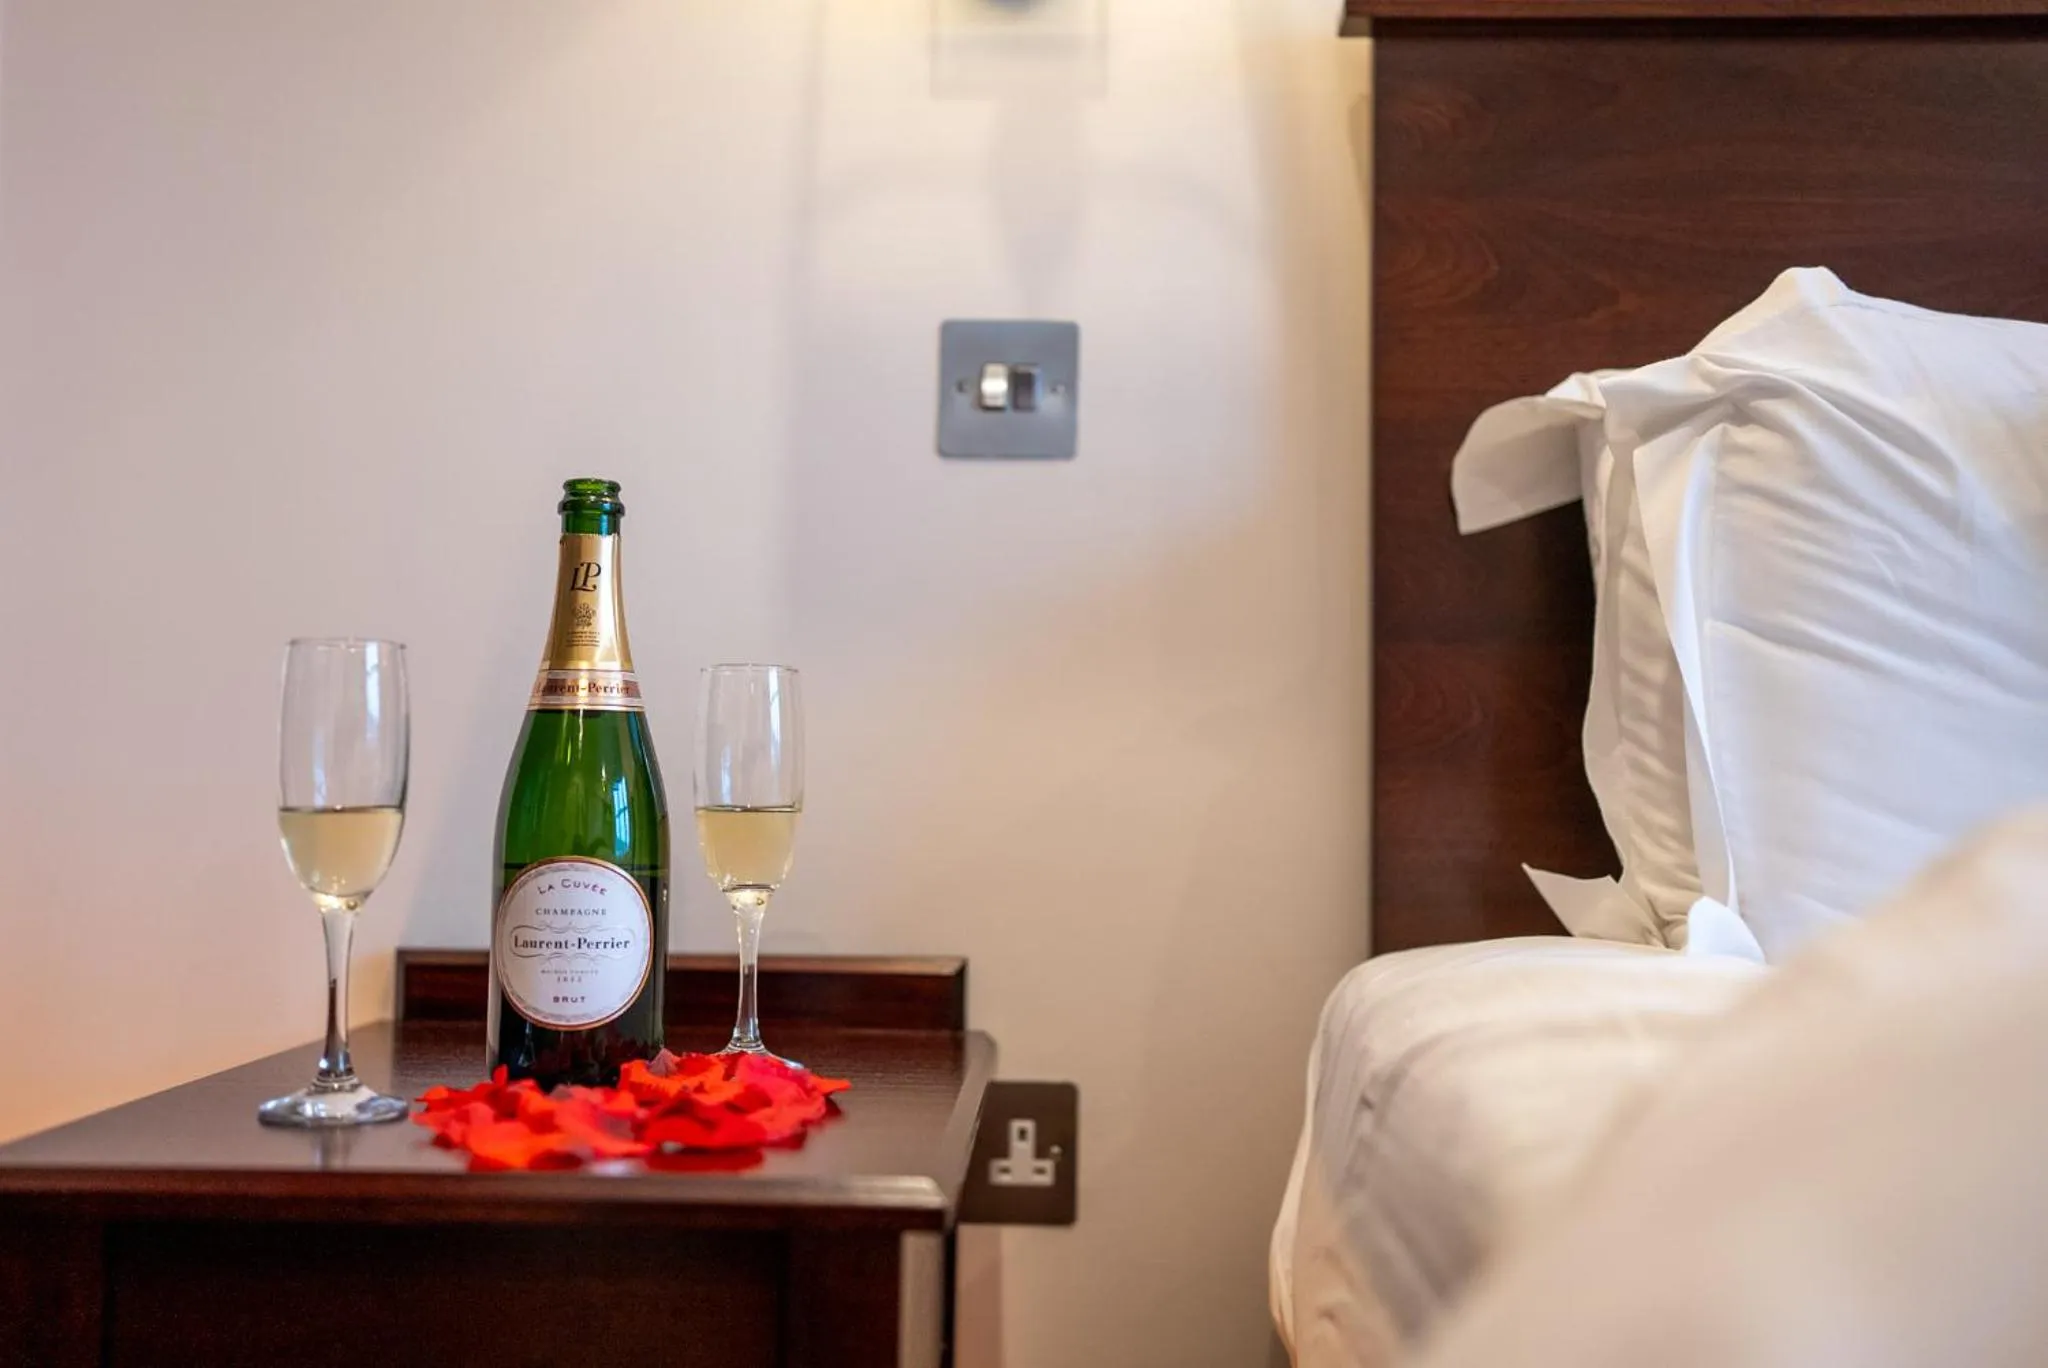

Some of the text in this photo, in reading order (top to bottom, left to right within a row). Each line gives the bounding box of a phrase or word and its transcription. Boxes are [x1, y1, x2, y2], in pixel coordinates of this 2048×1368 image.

[537, 884, 555, 895] LA
[535, 907, 607, 916] CHAMPAGNE
[514, 935, 630, 950] Laurent-Perrier
